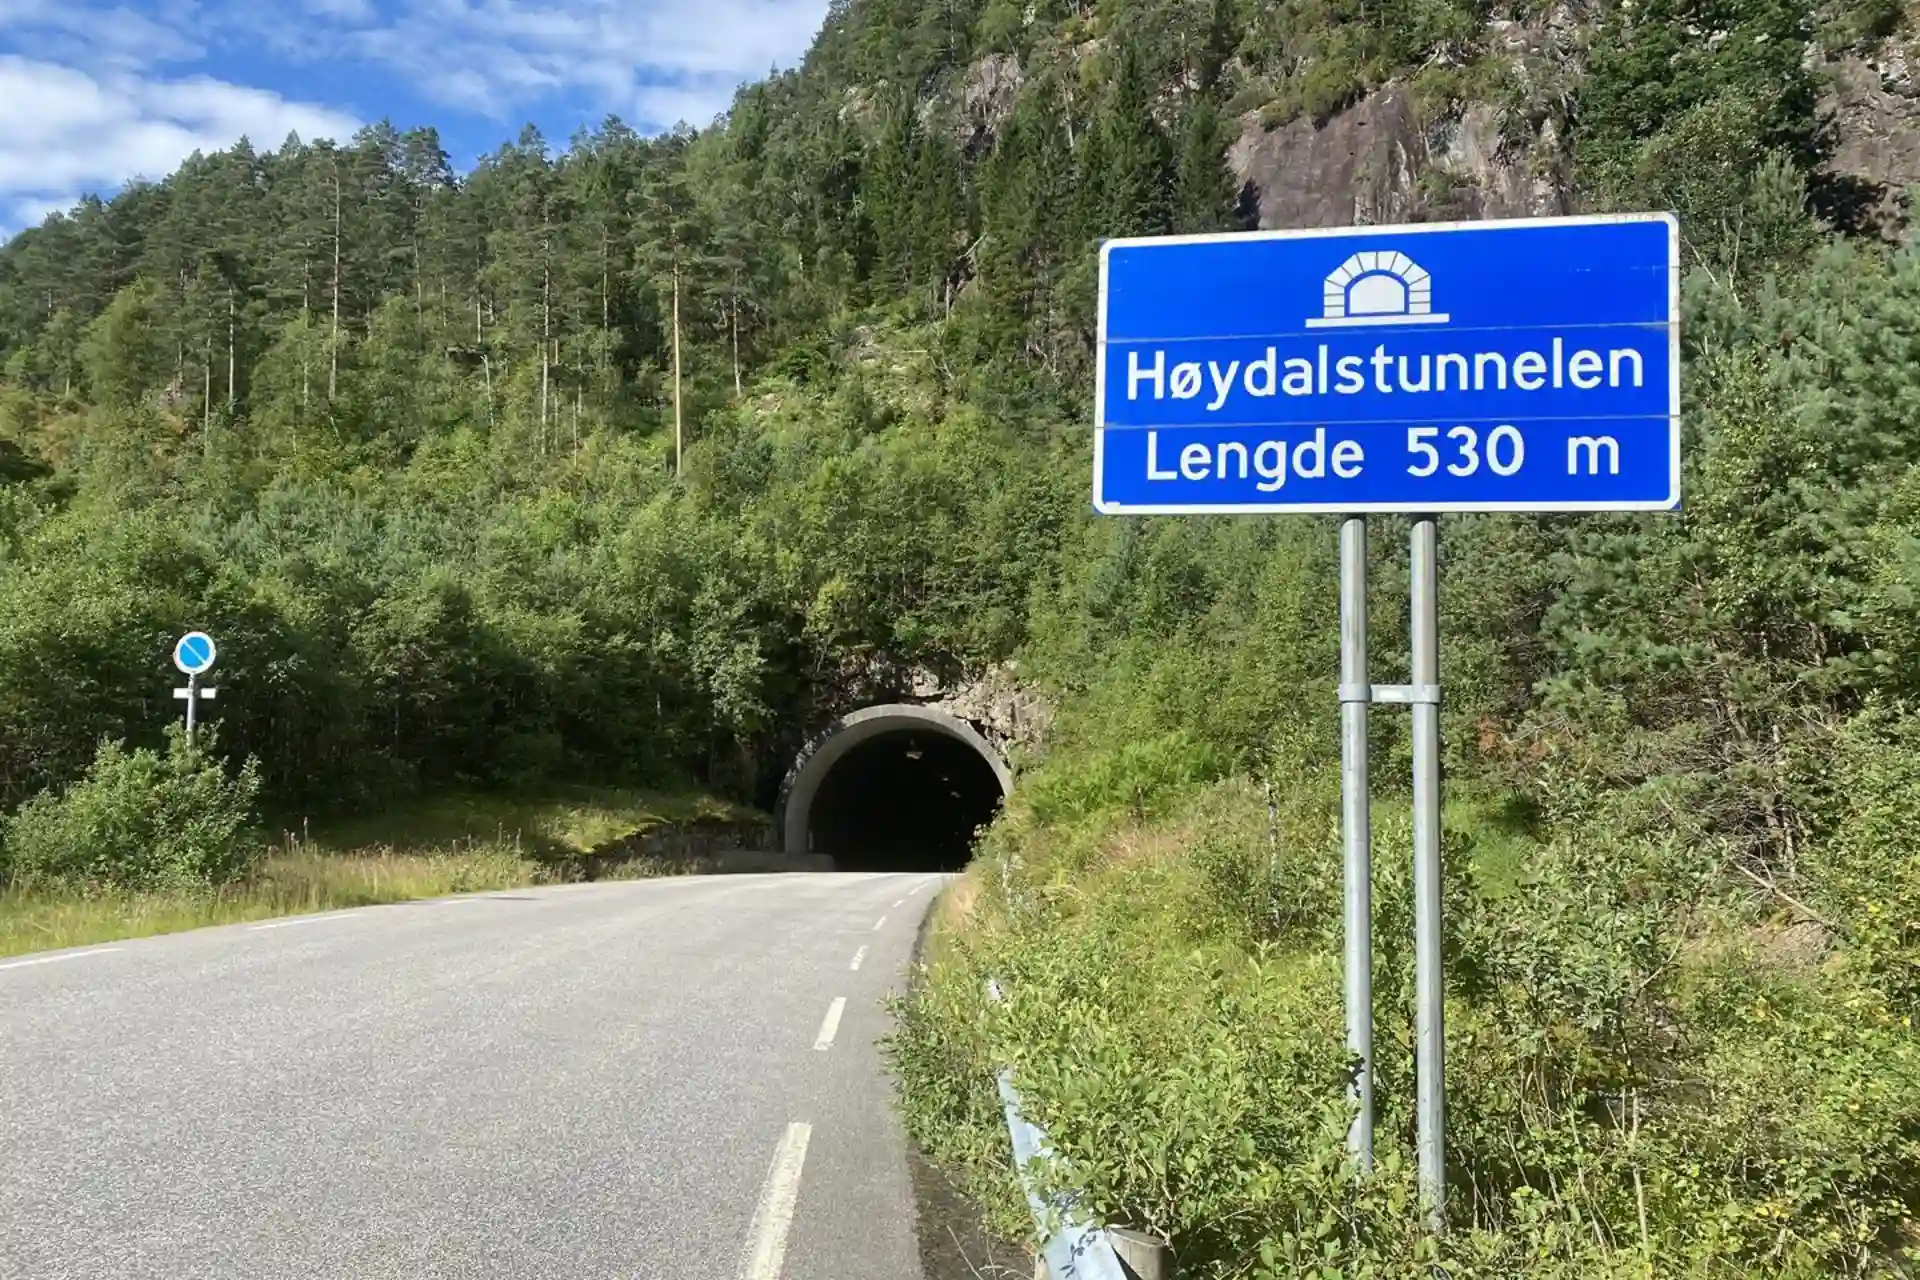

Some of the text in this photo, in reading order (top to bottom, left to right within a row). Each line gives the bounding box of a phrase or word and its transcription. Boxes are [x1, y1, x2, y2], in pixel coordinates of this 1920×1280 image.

[1127, 337, 1643, 411] Høydalstunnelen
[1147, 425, 1619, 492] Lengde 530 m
